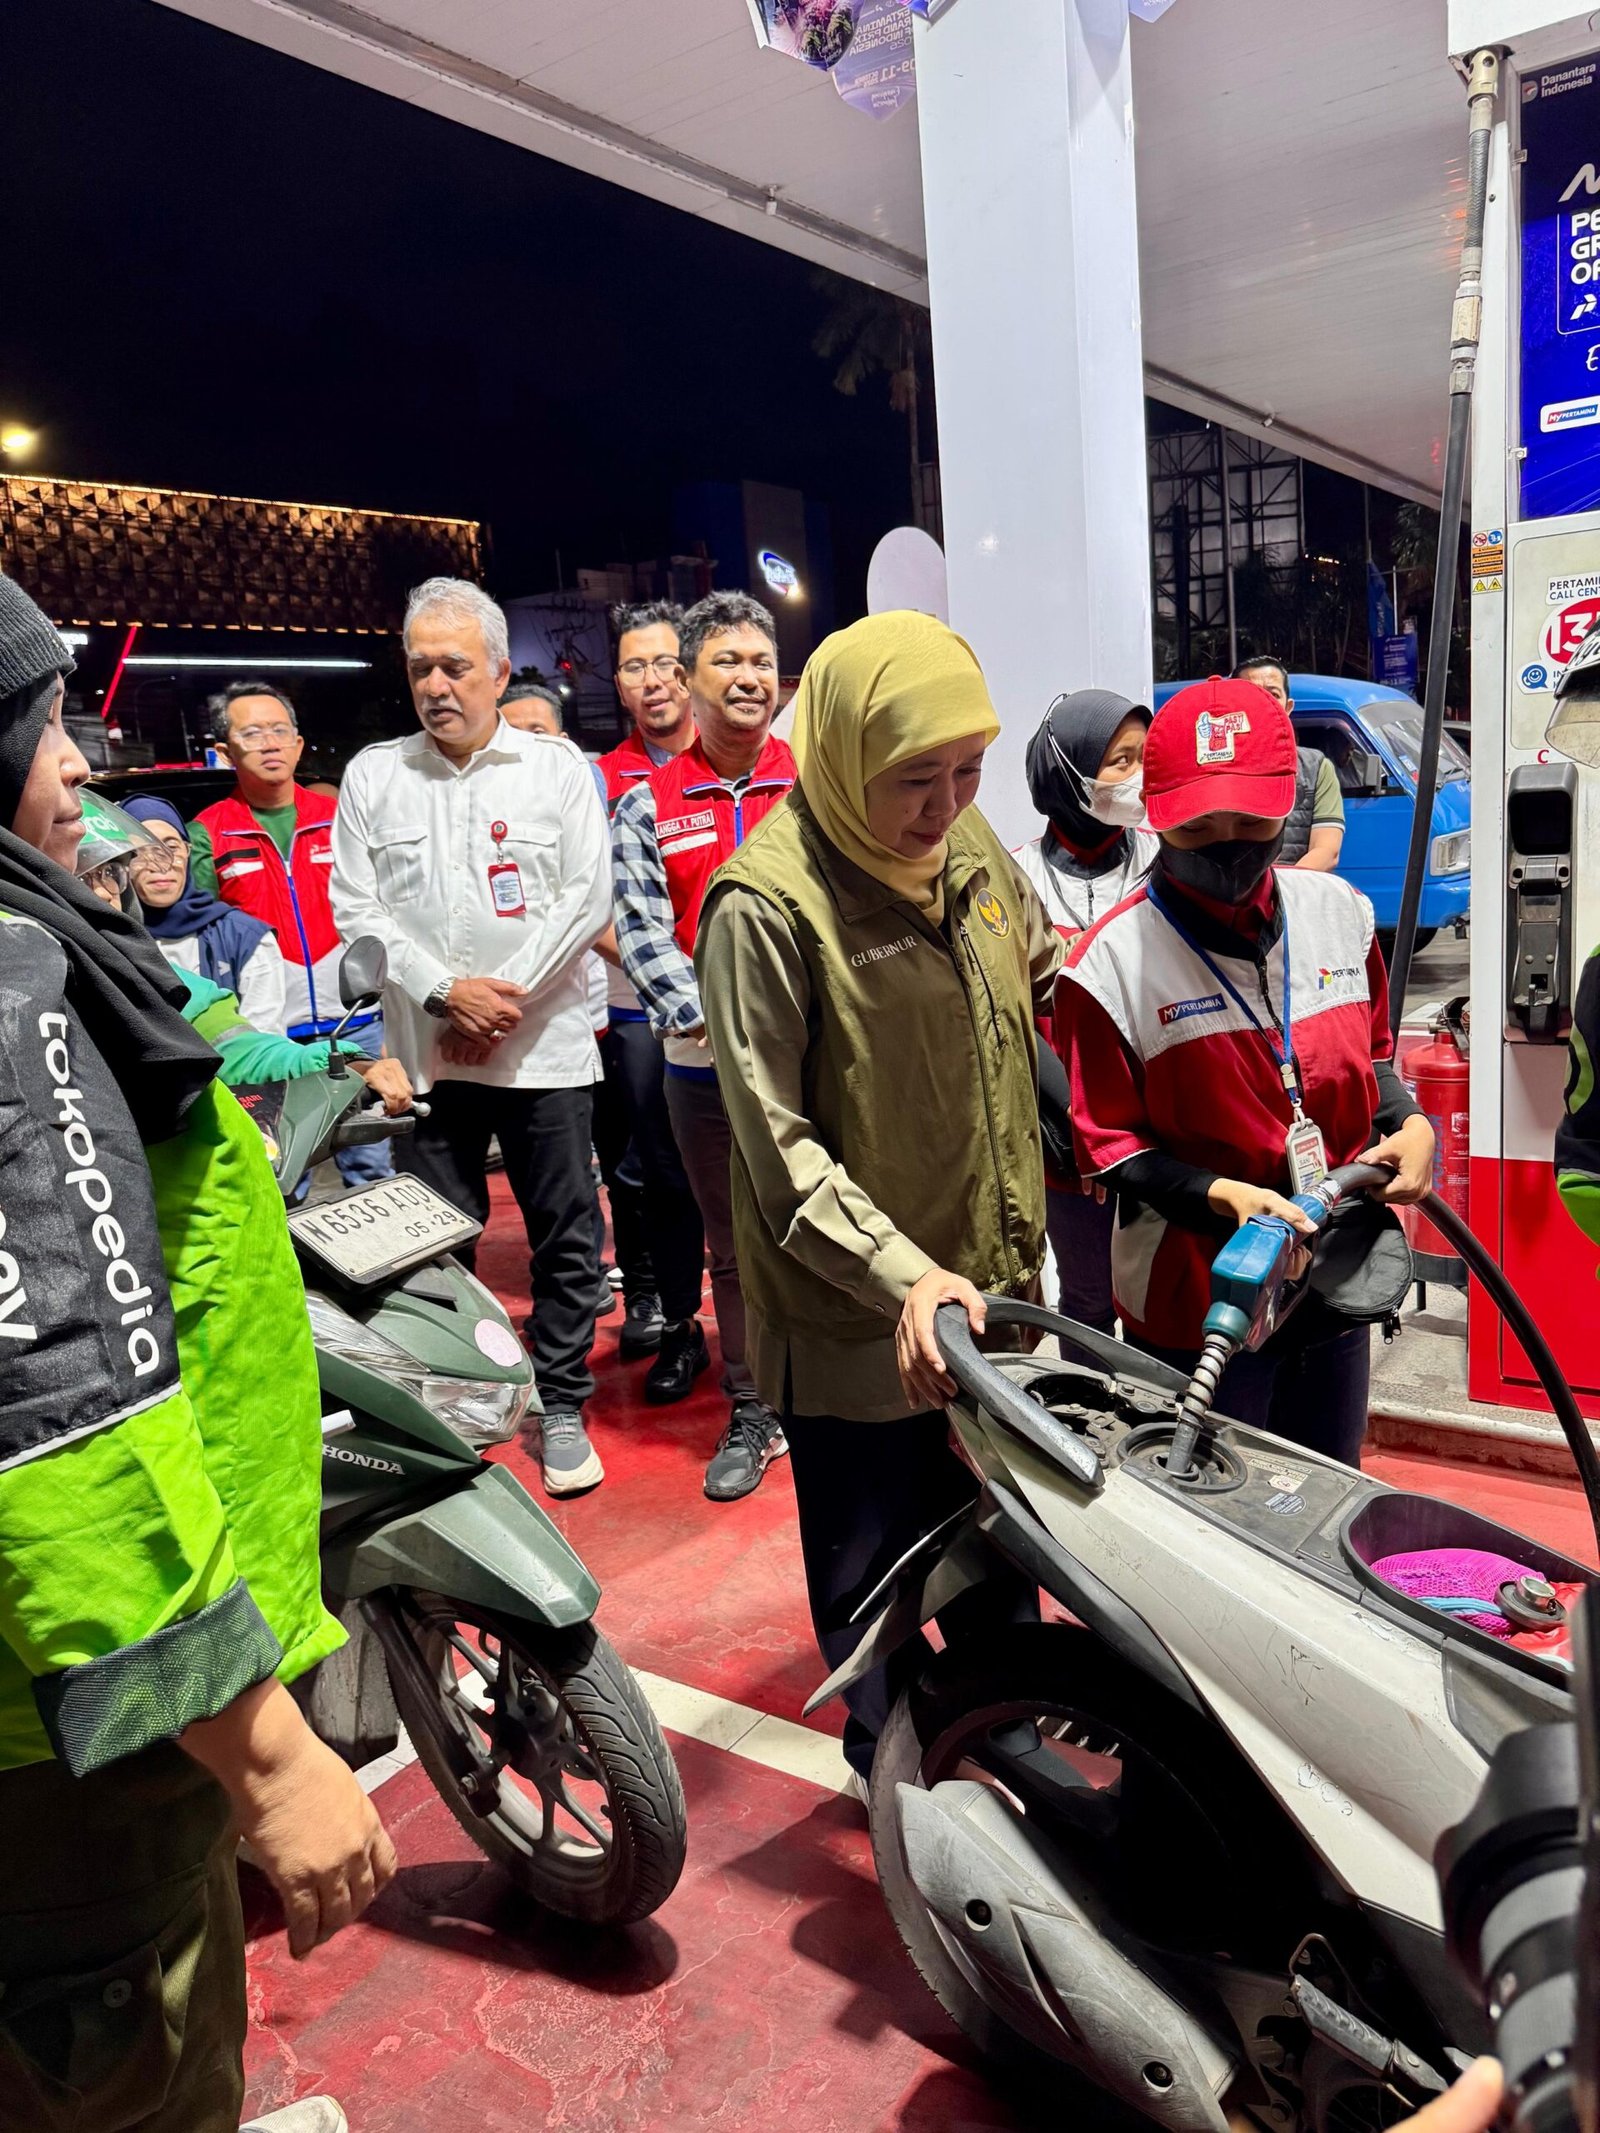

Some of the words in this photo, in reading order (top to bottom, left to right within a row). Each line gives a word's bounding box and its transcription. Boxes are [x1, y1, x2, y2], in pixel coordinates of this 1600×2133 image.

[1541, 63, 1597, 87] Danantara
[1541, 75, 1593, 98] Indonesia
[1550, 576, 1600, 591] PERTAMI
[1550, 589, 1575, 600] CALL
[1577, 586, 1600, 597] CEN
[1550, 611, 1600, 655] 13
[1537, 749, 1550, 764] C
[658, 820, 681, 836] ANGGA
[691, 813, 712, 829] PUTRA
[851, 935, 917, 967] GUBERNUR
[38, 1011, 161, 1377] tokopedia
[299, 1219, 334, 1245] N
[320, 1197, 391, 1235] 6536
[321, 1443, 406, 1476] HONDA
